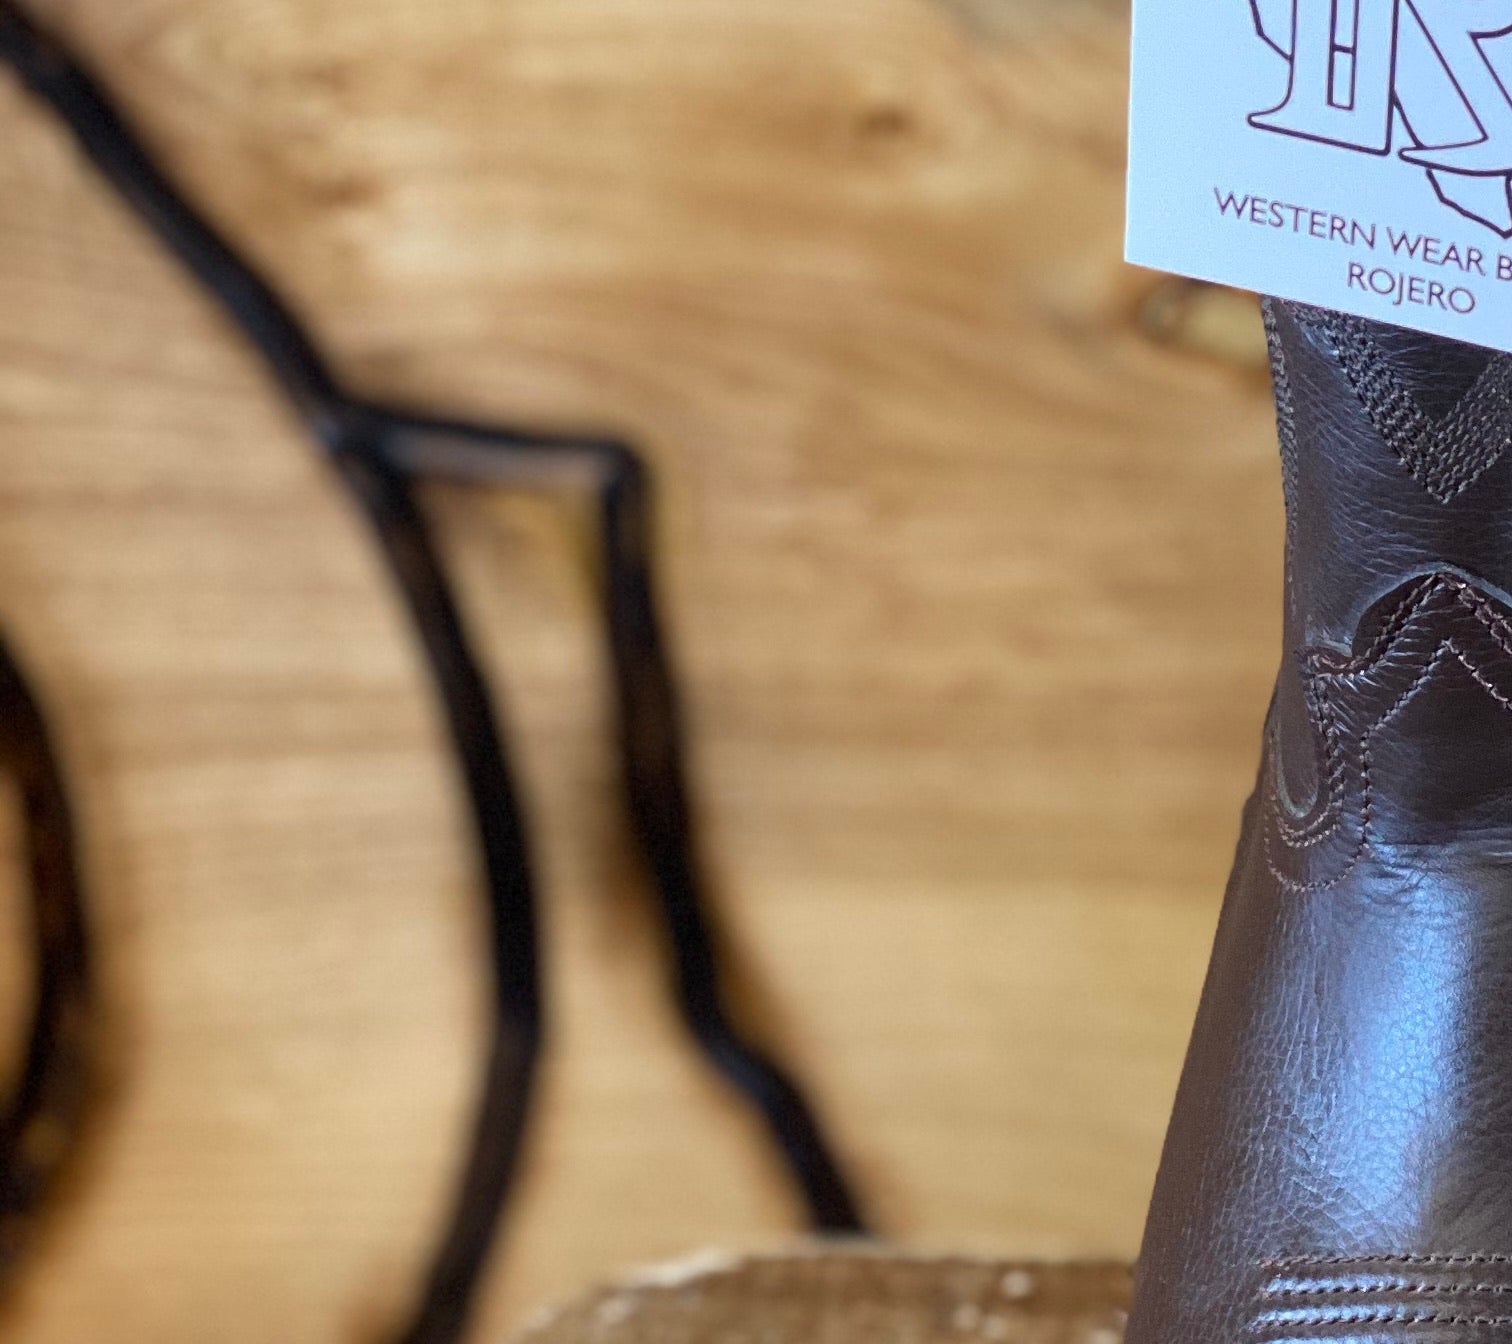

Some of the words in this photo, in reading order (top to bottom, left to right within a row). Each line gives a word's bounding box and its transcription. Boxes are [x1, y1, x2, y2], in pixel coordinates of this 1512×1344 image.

[1213, 186, 1376, 250] WESTERN
[1386, 226, 1485, 276] WEAR
[1346, 262, 1476, 314] ROJERO
